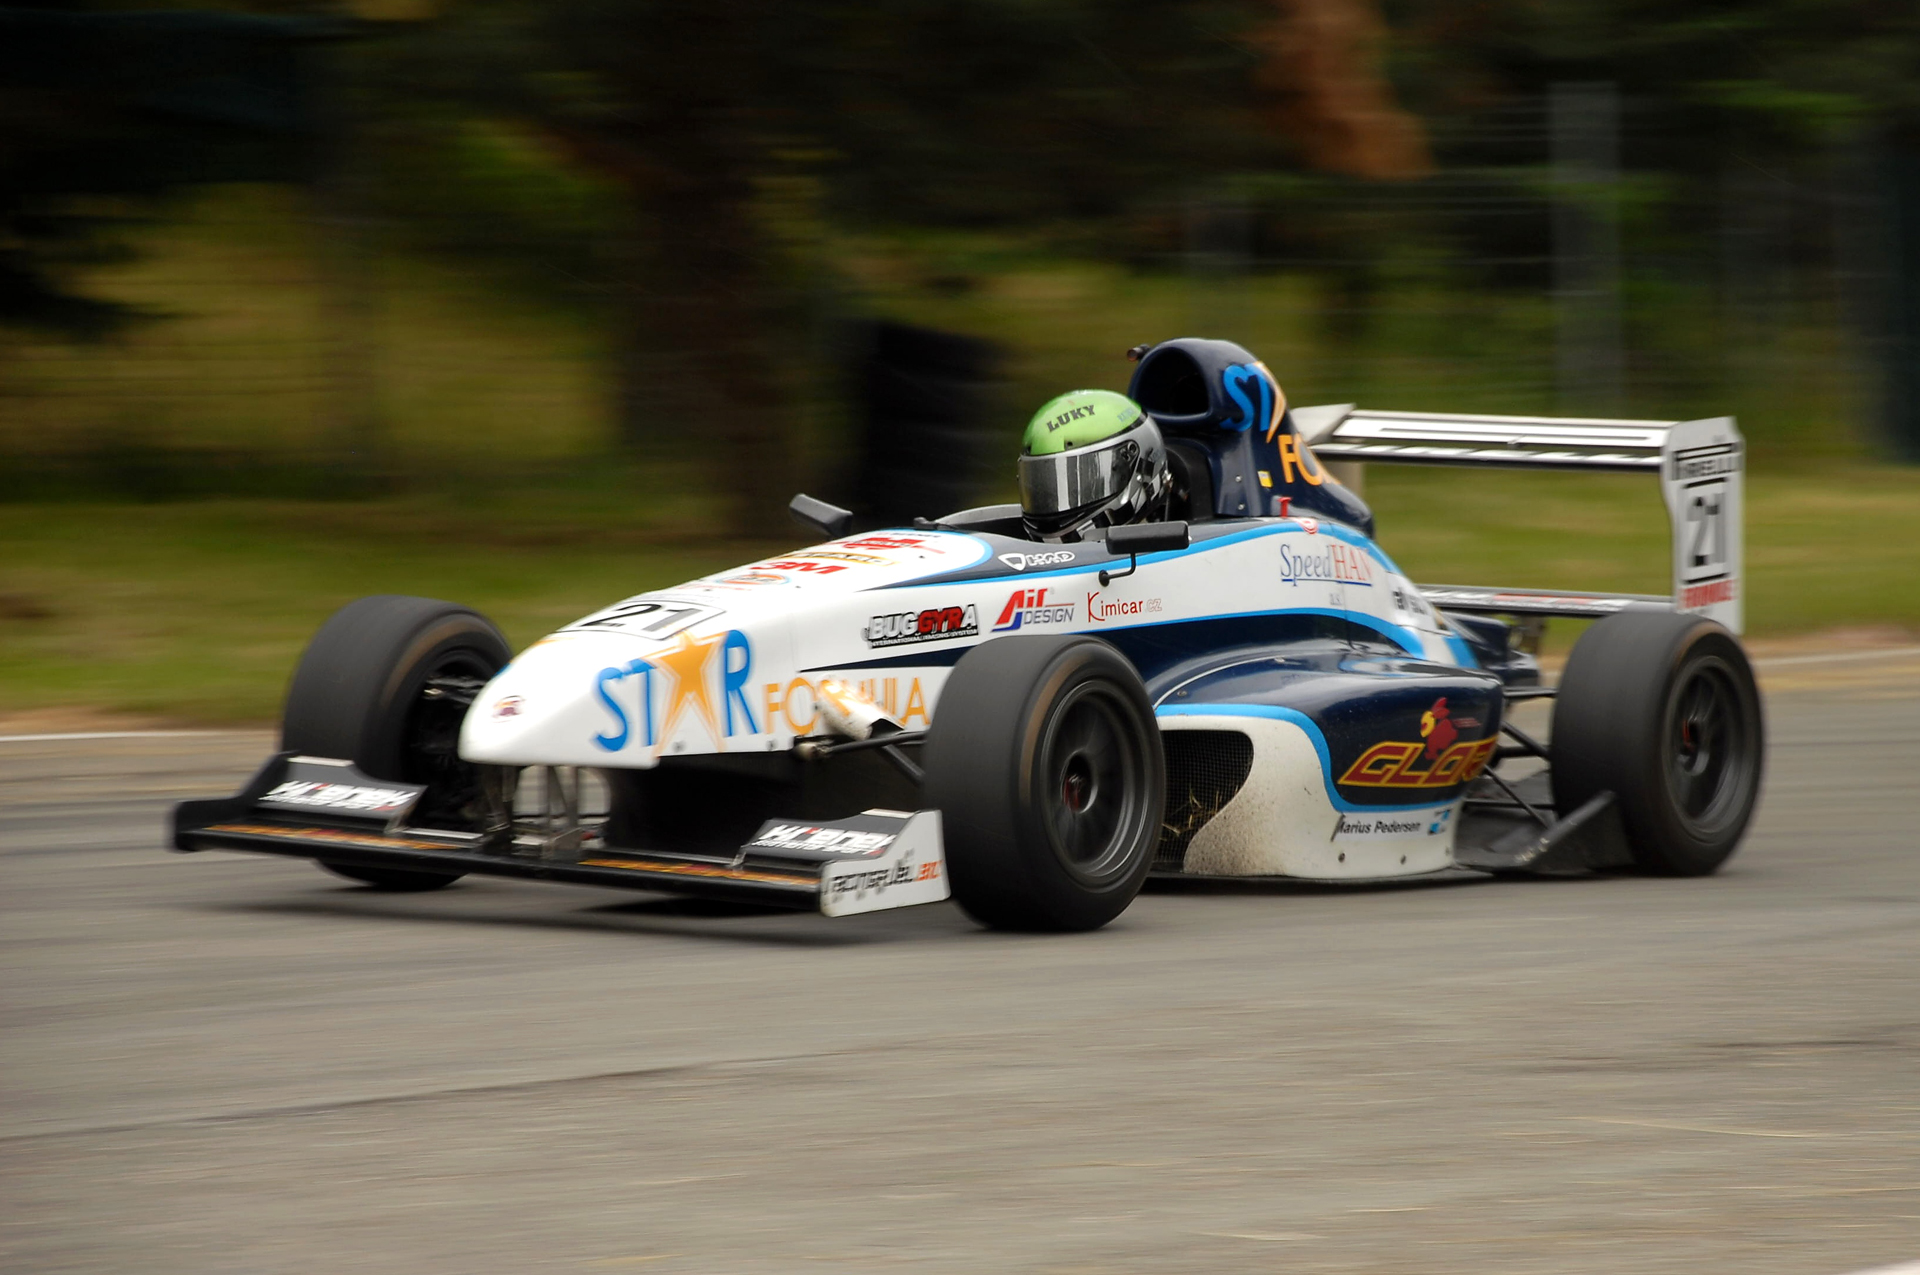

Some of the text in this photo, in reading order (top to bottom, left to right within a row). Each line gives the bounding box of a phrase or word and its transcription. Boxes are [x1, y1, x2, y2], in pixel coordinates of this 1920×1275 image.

[1046, 404, 1096, 432] LUKY
[1687, 493, 1727, 568] 21
[752, 562, 848, 575] 3M
[580, 603, 703, 632] 21
[869, 604, 977, 639] BUGGYRA
[1024, 607, 1076, 625] DESIGN
[1373, 820, 1421, 834] Pedersen
